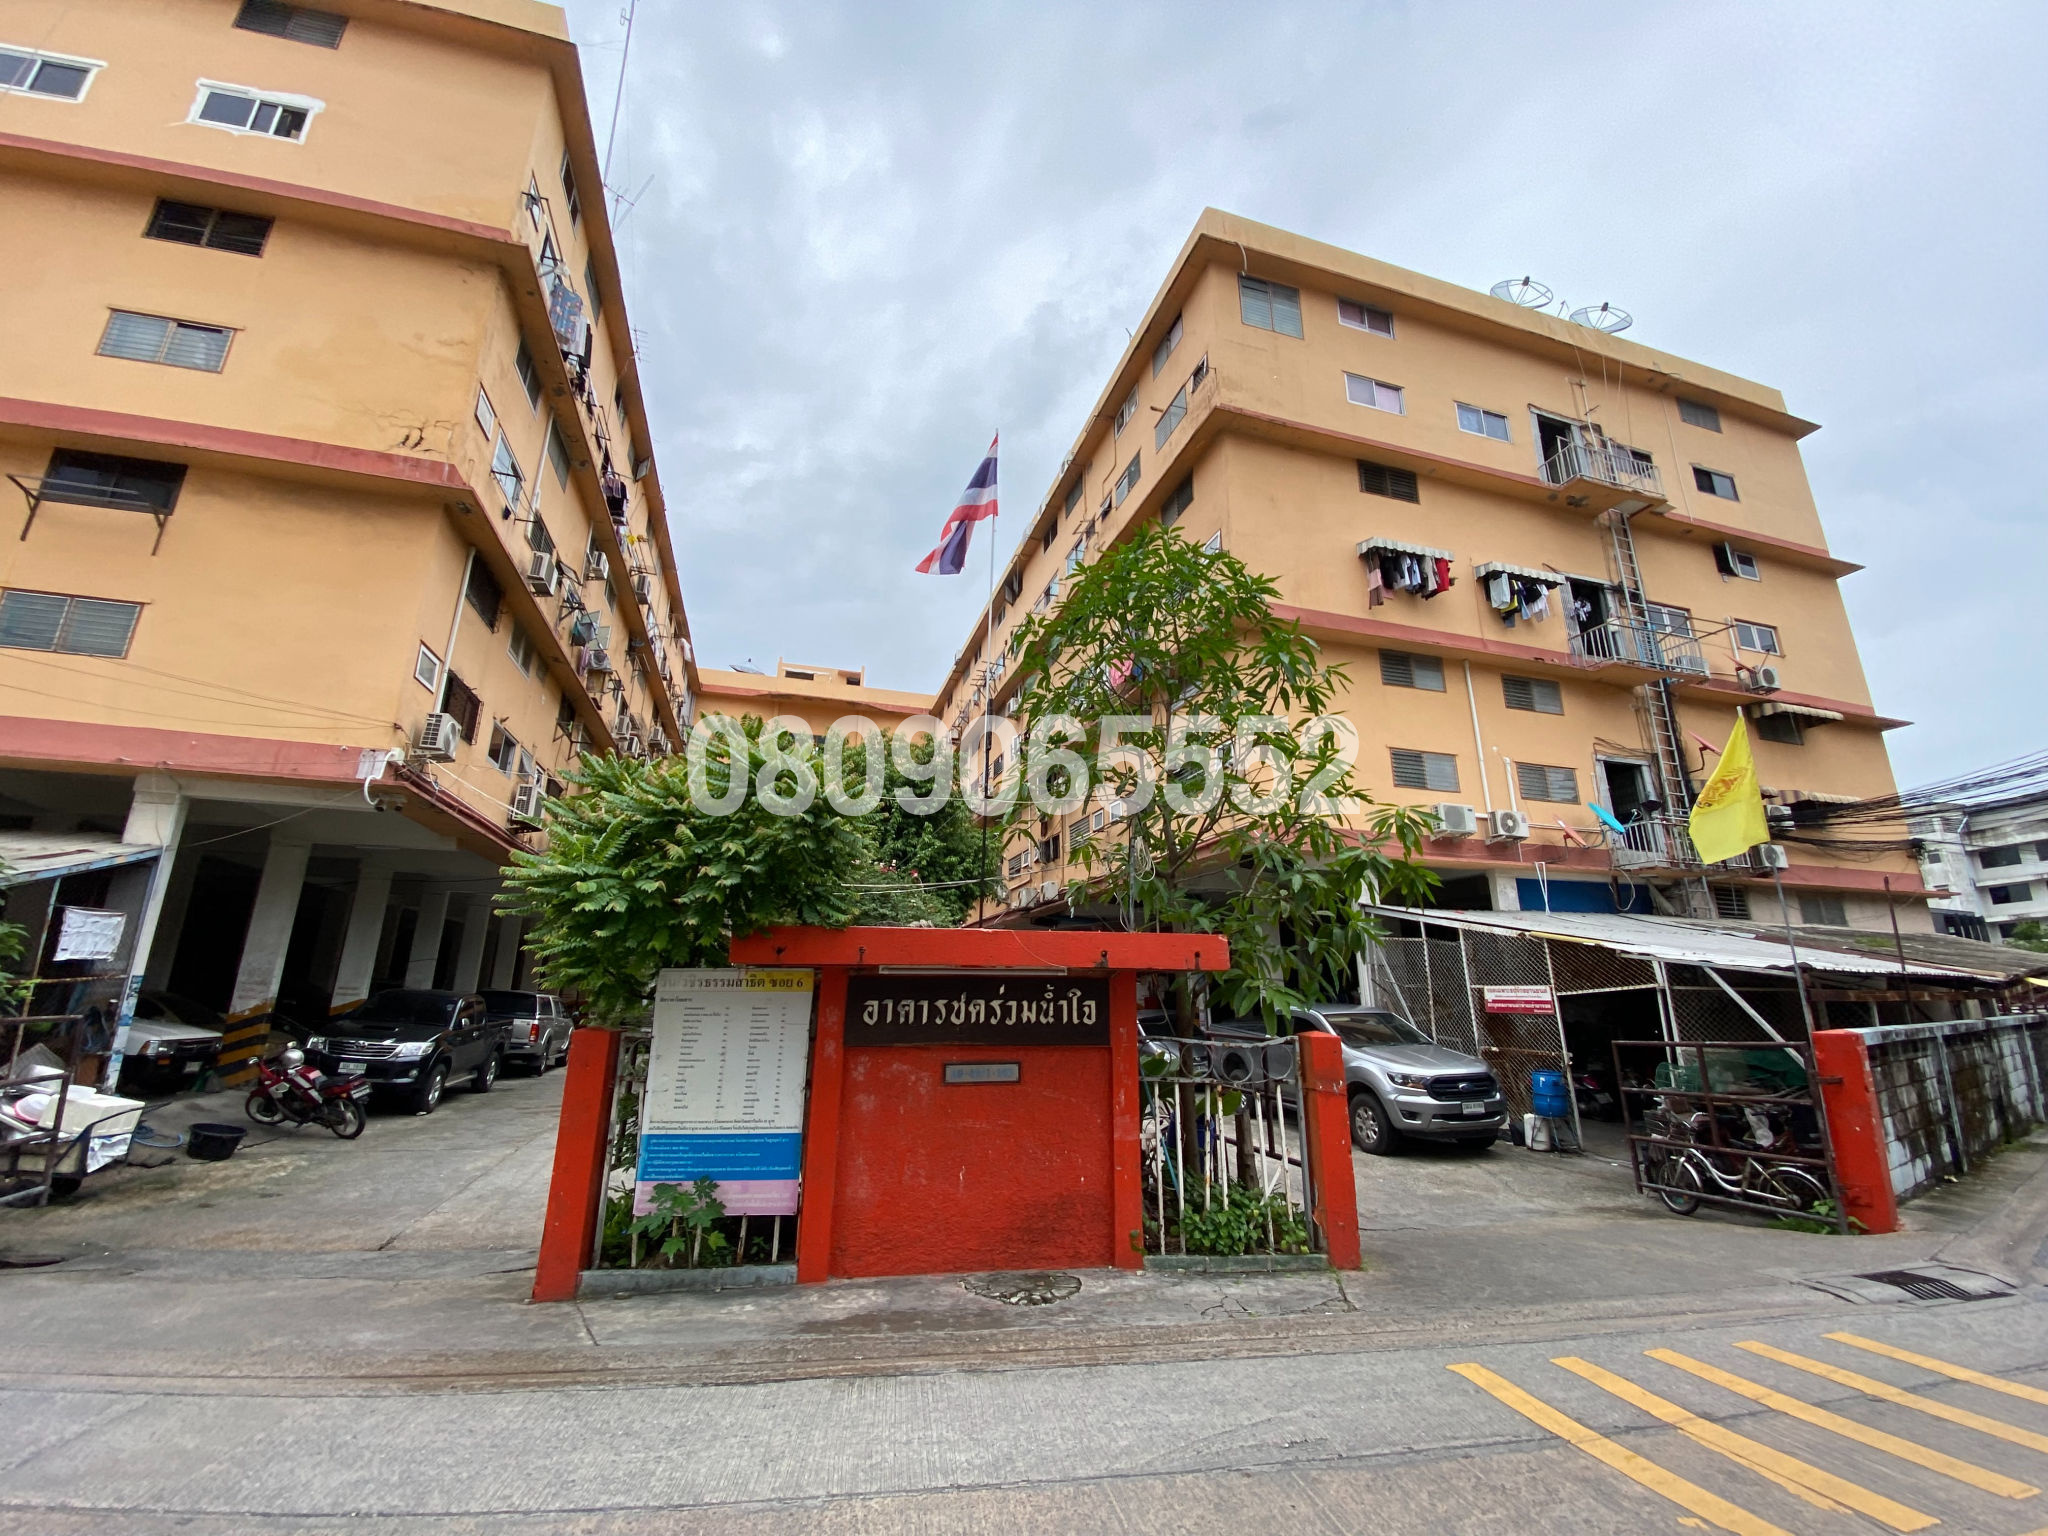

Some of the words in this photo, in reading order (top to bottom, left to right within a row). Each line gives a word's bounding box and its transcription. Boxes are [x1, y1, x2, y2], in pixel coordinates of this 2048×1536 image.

[796, 977, 804, 988] 6
[862, 983, 1098, 1028] อาคารชดร่วมน้ำใจ
